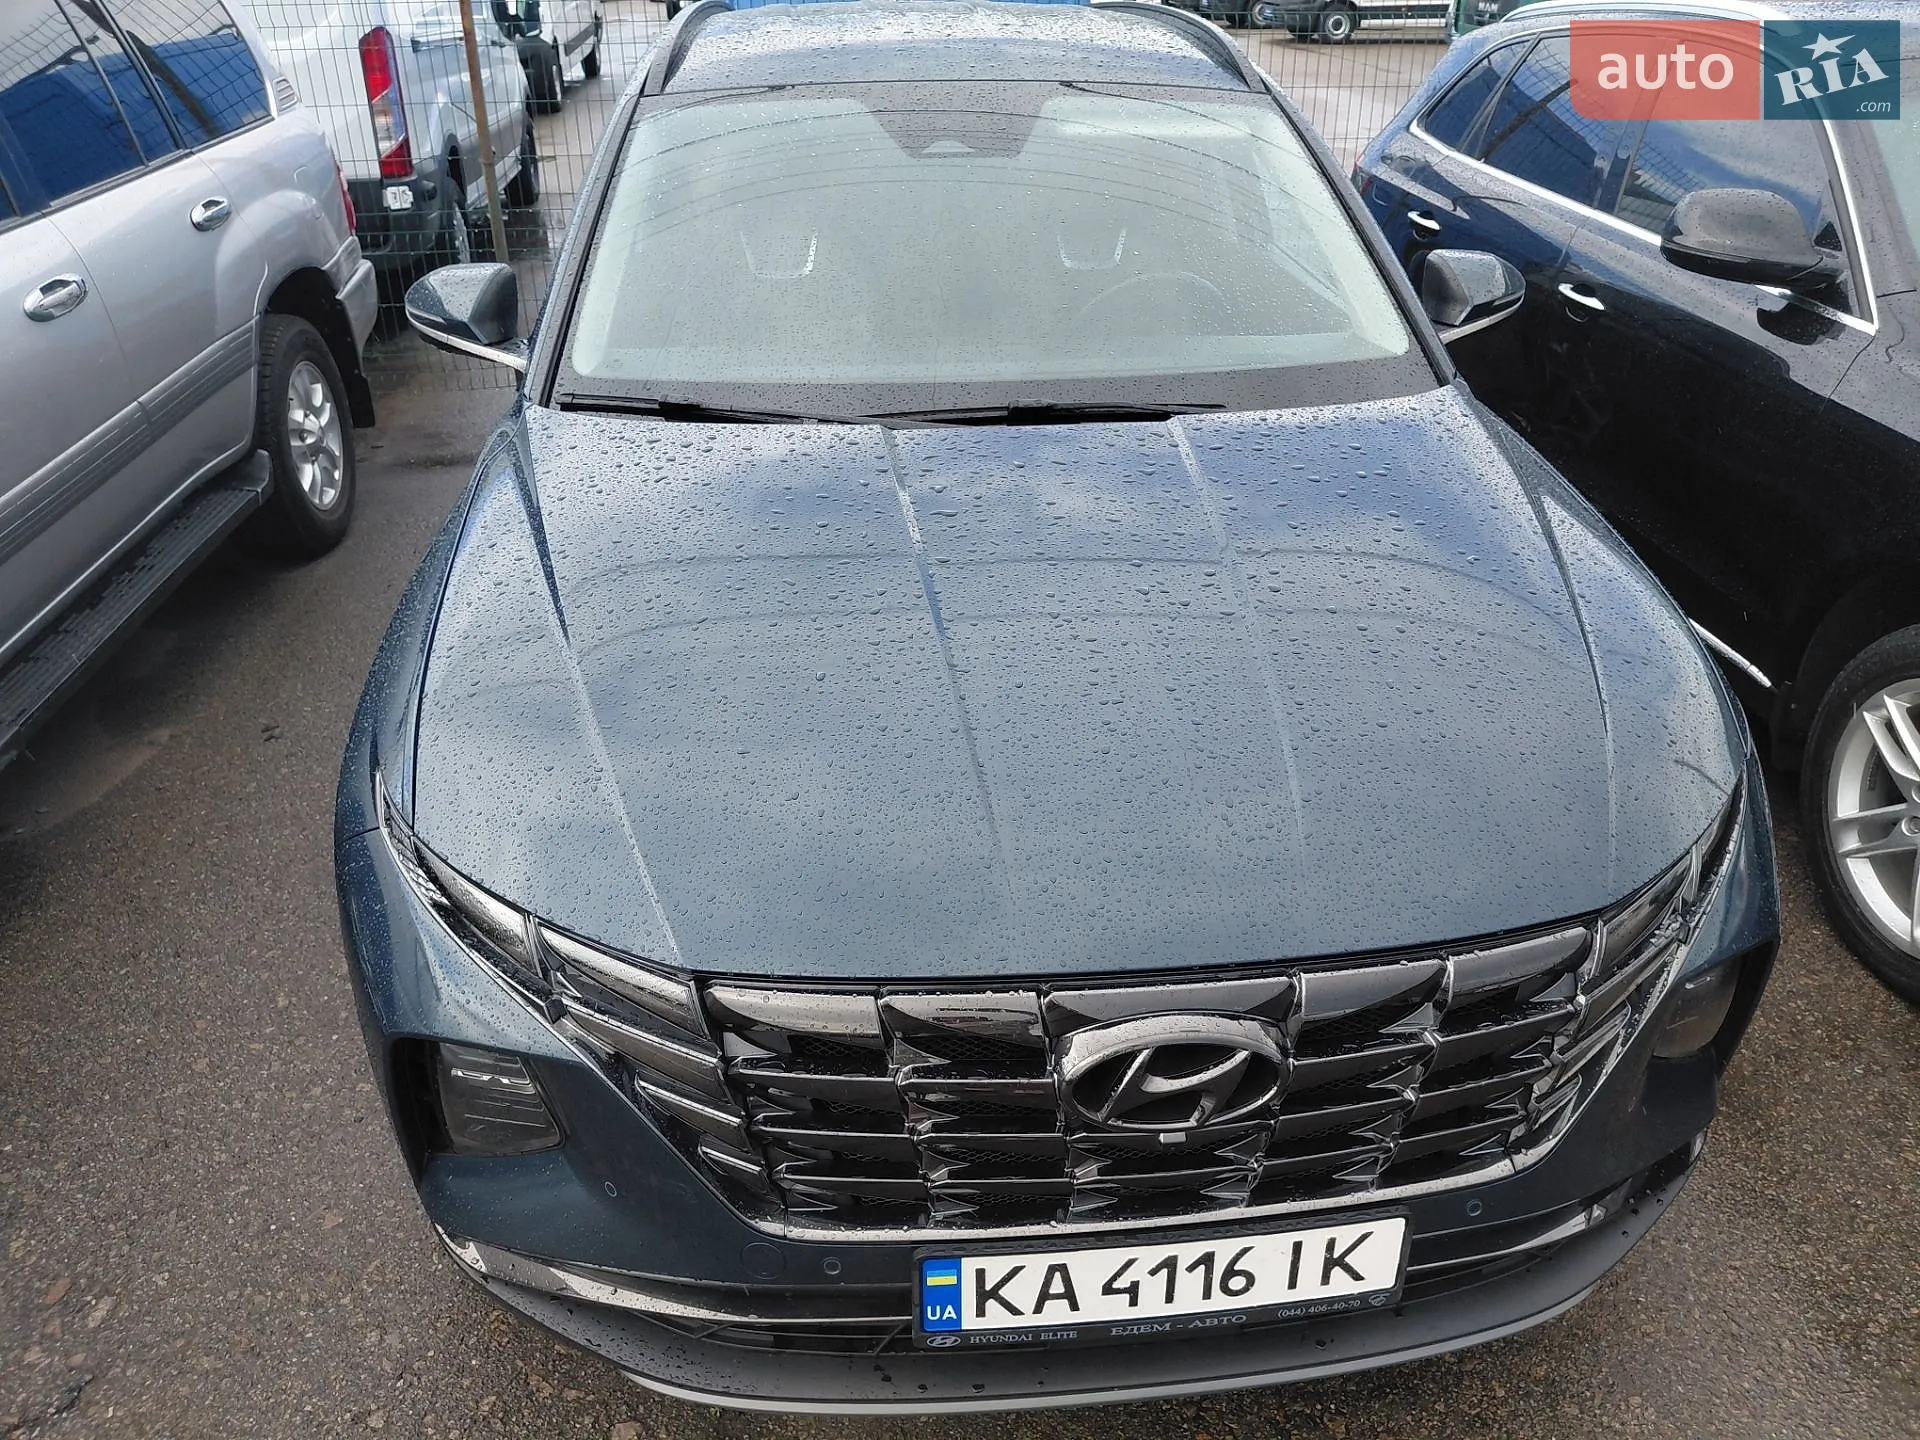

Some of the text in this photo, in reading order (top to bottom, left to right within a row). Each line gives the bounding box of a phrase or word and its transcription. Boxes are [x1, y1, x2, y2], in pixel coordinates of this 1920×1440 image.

[975, 1231, 1375, 1318] KA 4116 IK
[927, 1304, 957, 1320] UA
[1277, 1300, 1361, 1320] (044) 406-40-70
[1110, 1323, 1171, 1336] ЕДЕМ
[1188, 1314, 1247, 1328] АВТО
[970, 1330, 1078, 1344] HYUNDAI ELITE
